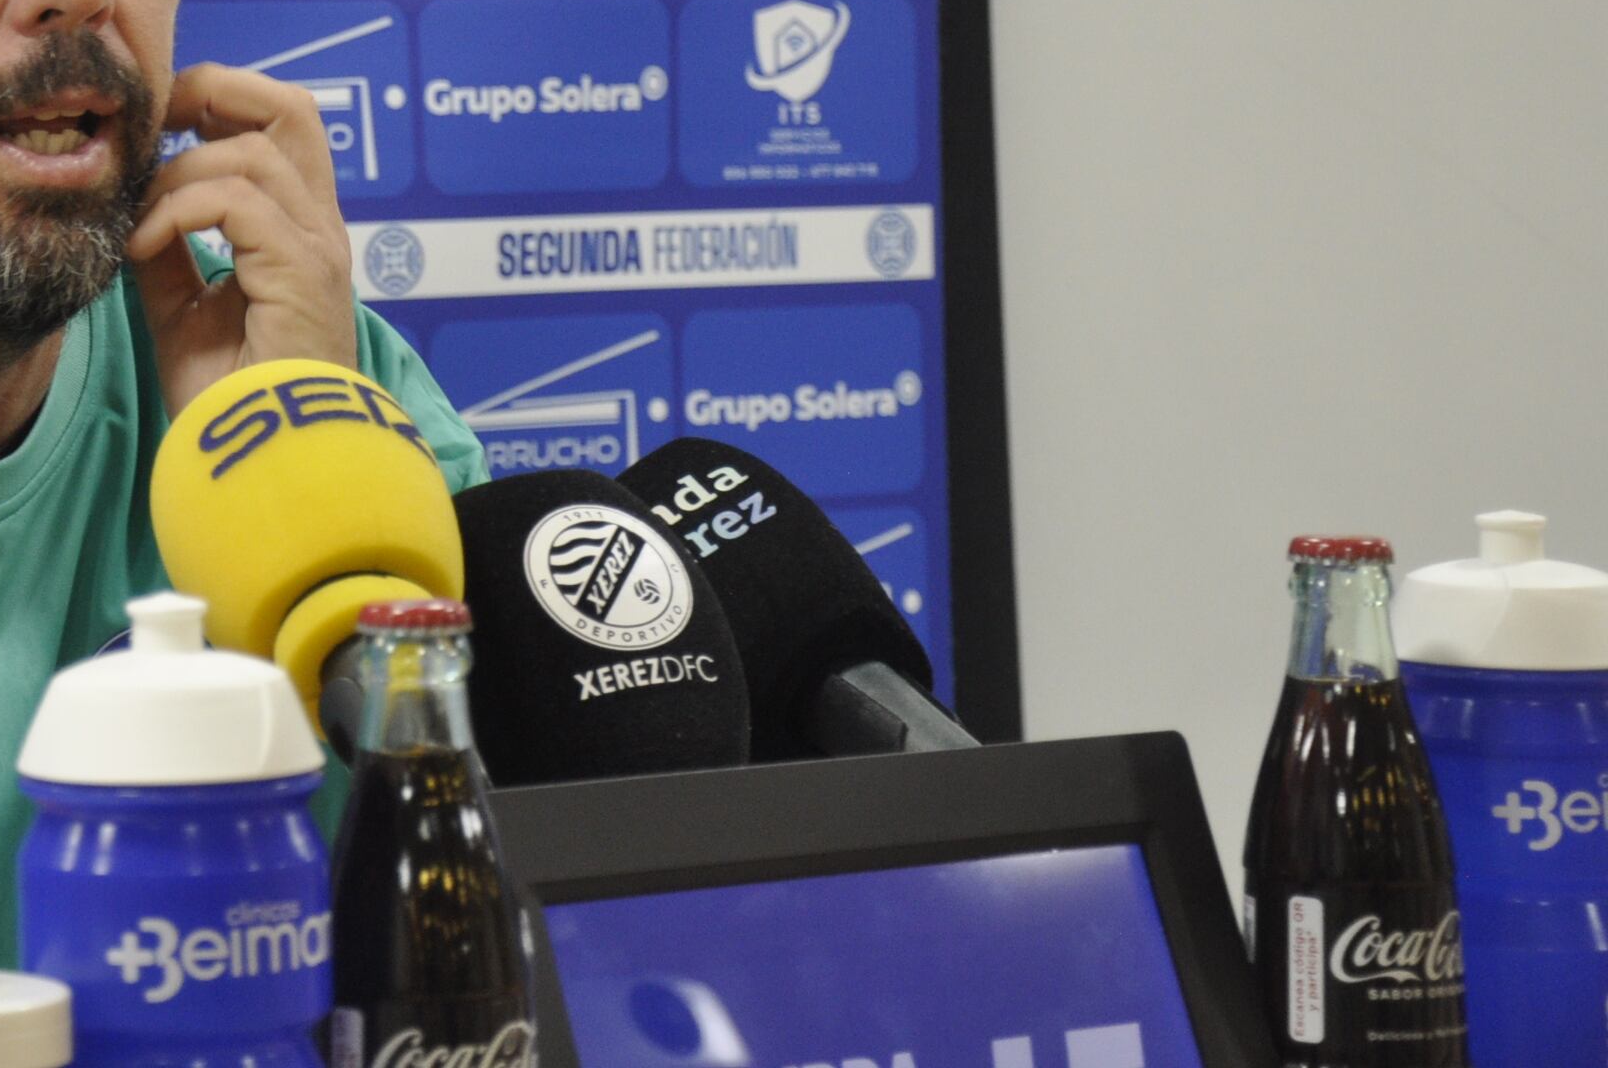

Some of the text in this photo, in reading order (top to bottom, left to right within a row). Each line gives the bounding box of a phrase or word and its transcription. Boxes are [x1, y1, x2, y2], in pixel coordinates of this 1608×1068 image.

[425, 75, 642, 122] Grupo Solera
[499, 221, 798, 278] SEGUNDA FEDERACIÓN
[685, 381, 898, 431] Grupo Solera
[684, 491, 777, 559] rez
[586, 530, 636, 615] XEREZ
[575, 604, 683, 643] DEPORTIVO
[573, 654, 718, 701] XEREZDFC
[1368, 988, 1424, 1000] SABOR
